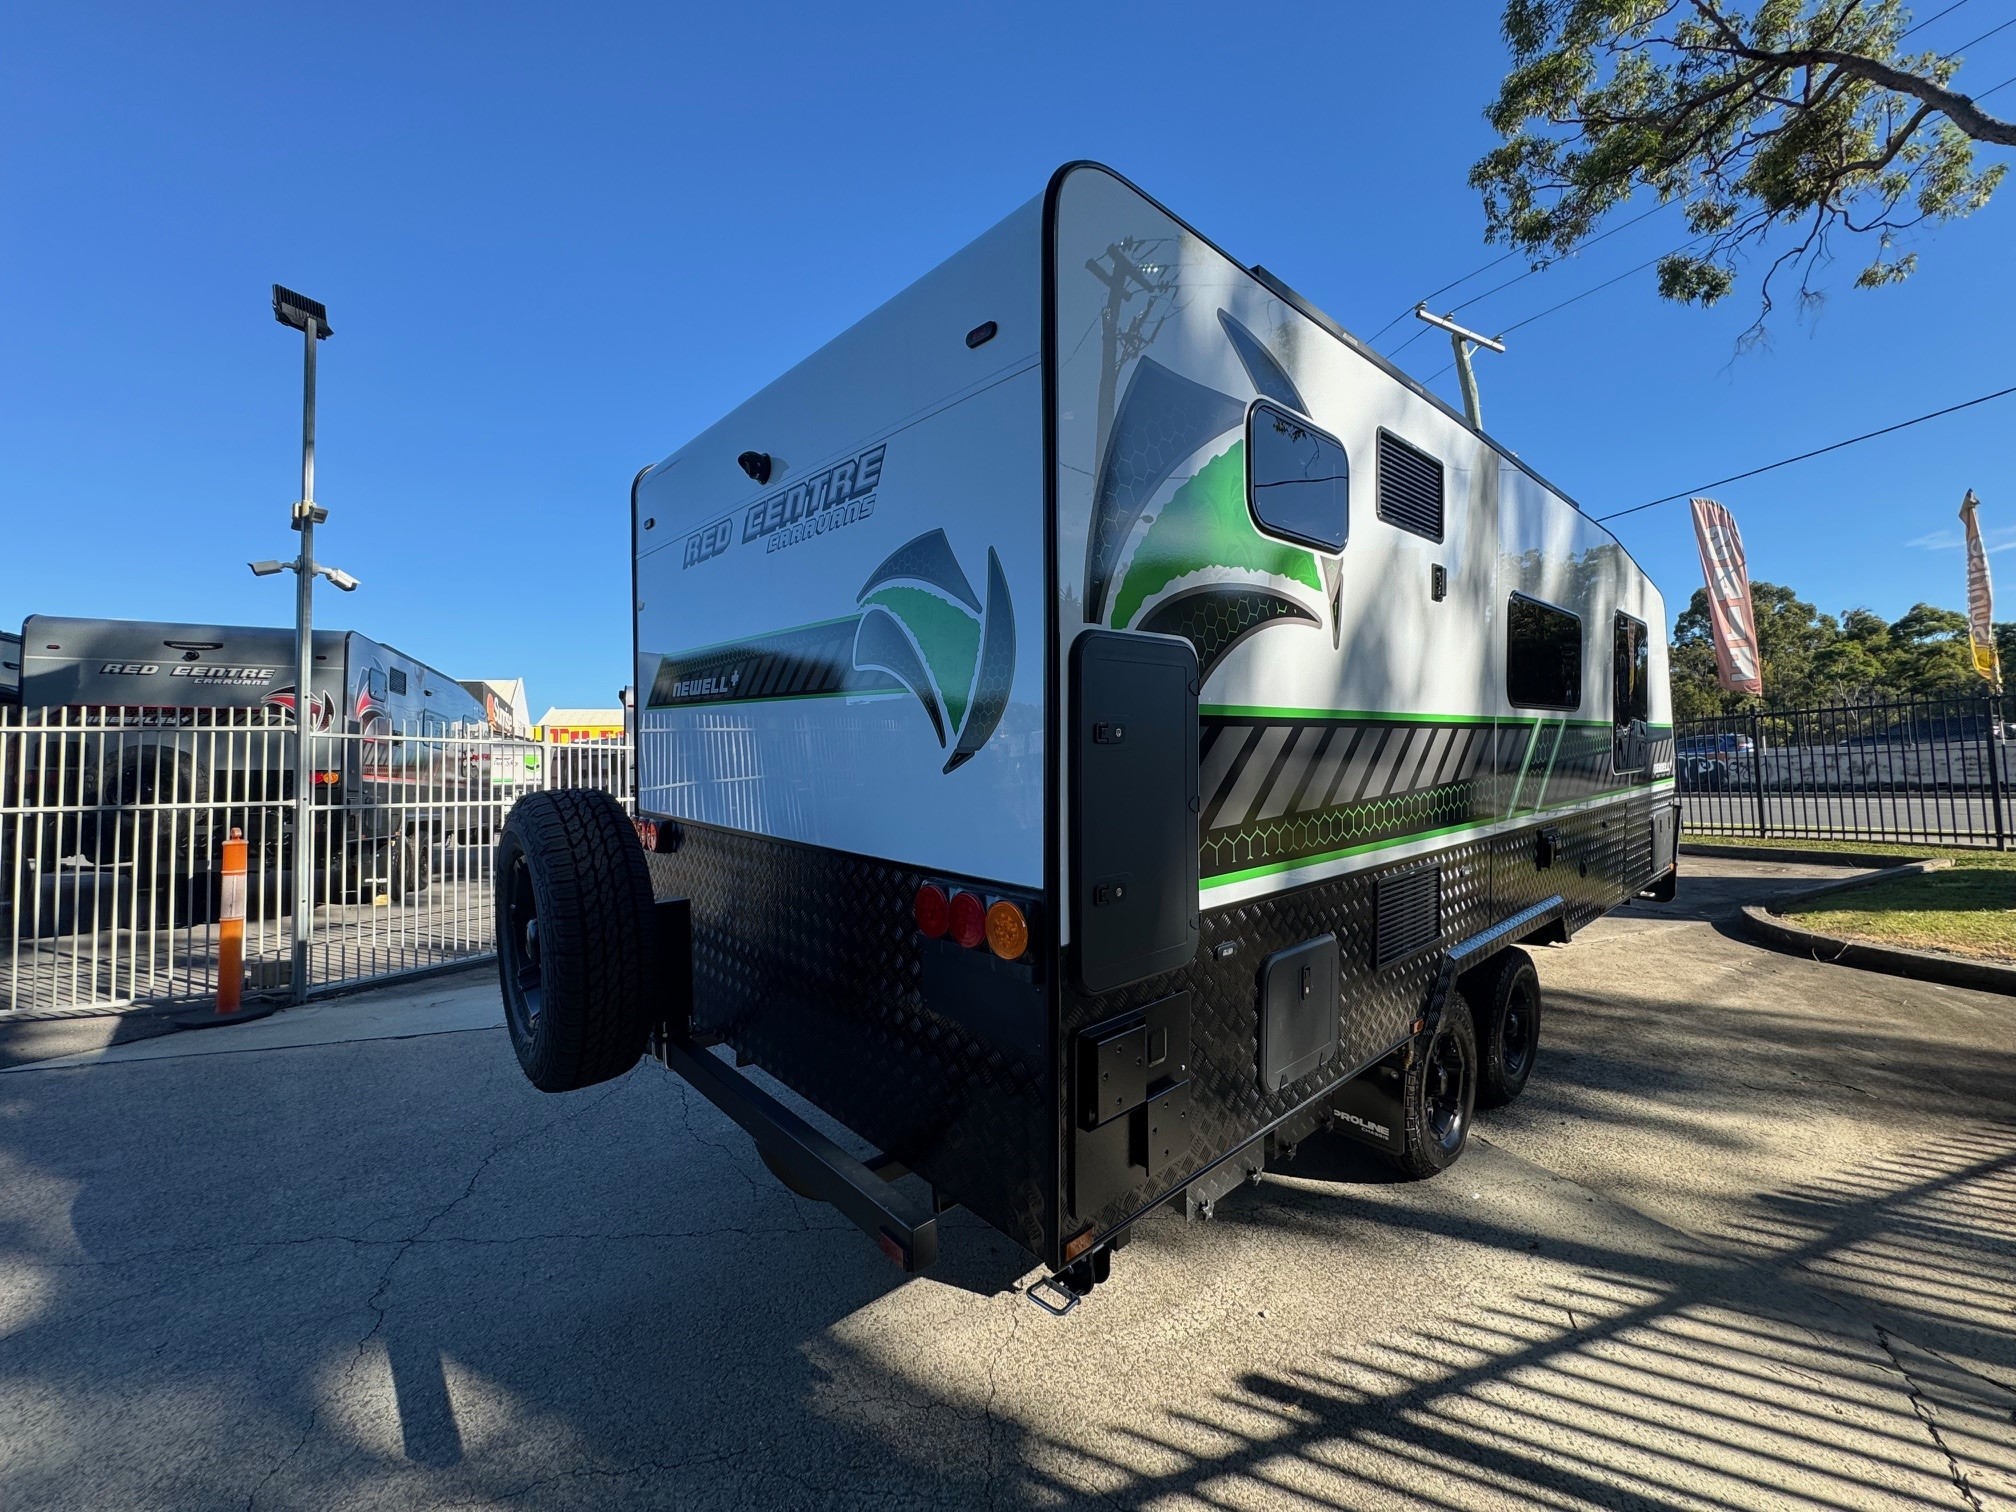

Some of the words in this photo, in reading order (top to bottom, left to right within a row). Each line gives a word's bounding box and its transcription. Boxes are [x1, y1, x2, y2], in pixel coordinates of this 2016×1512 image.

[683, 518, 734, 570] RED
[742, 443, 887, 545] CENTRE
[767, 493, 877, 554] CARAVANS
[99, 663, 160, 676] RED
[170, 666, 276, 679] CENTRE
[194, 678, 271, 686] CARAVANS
